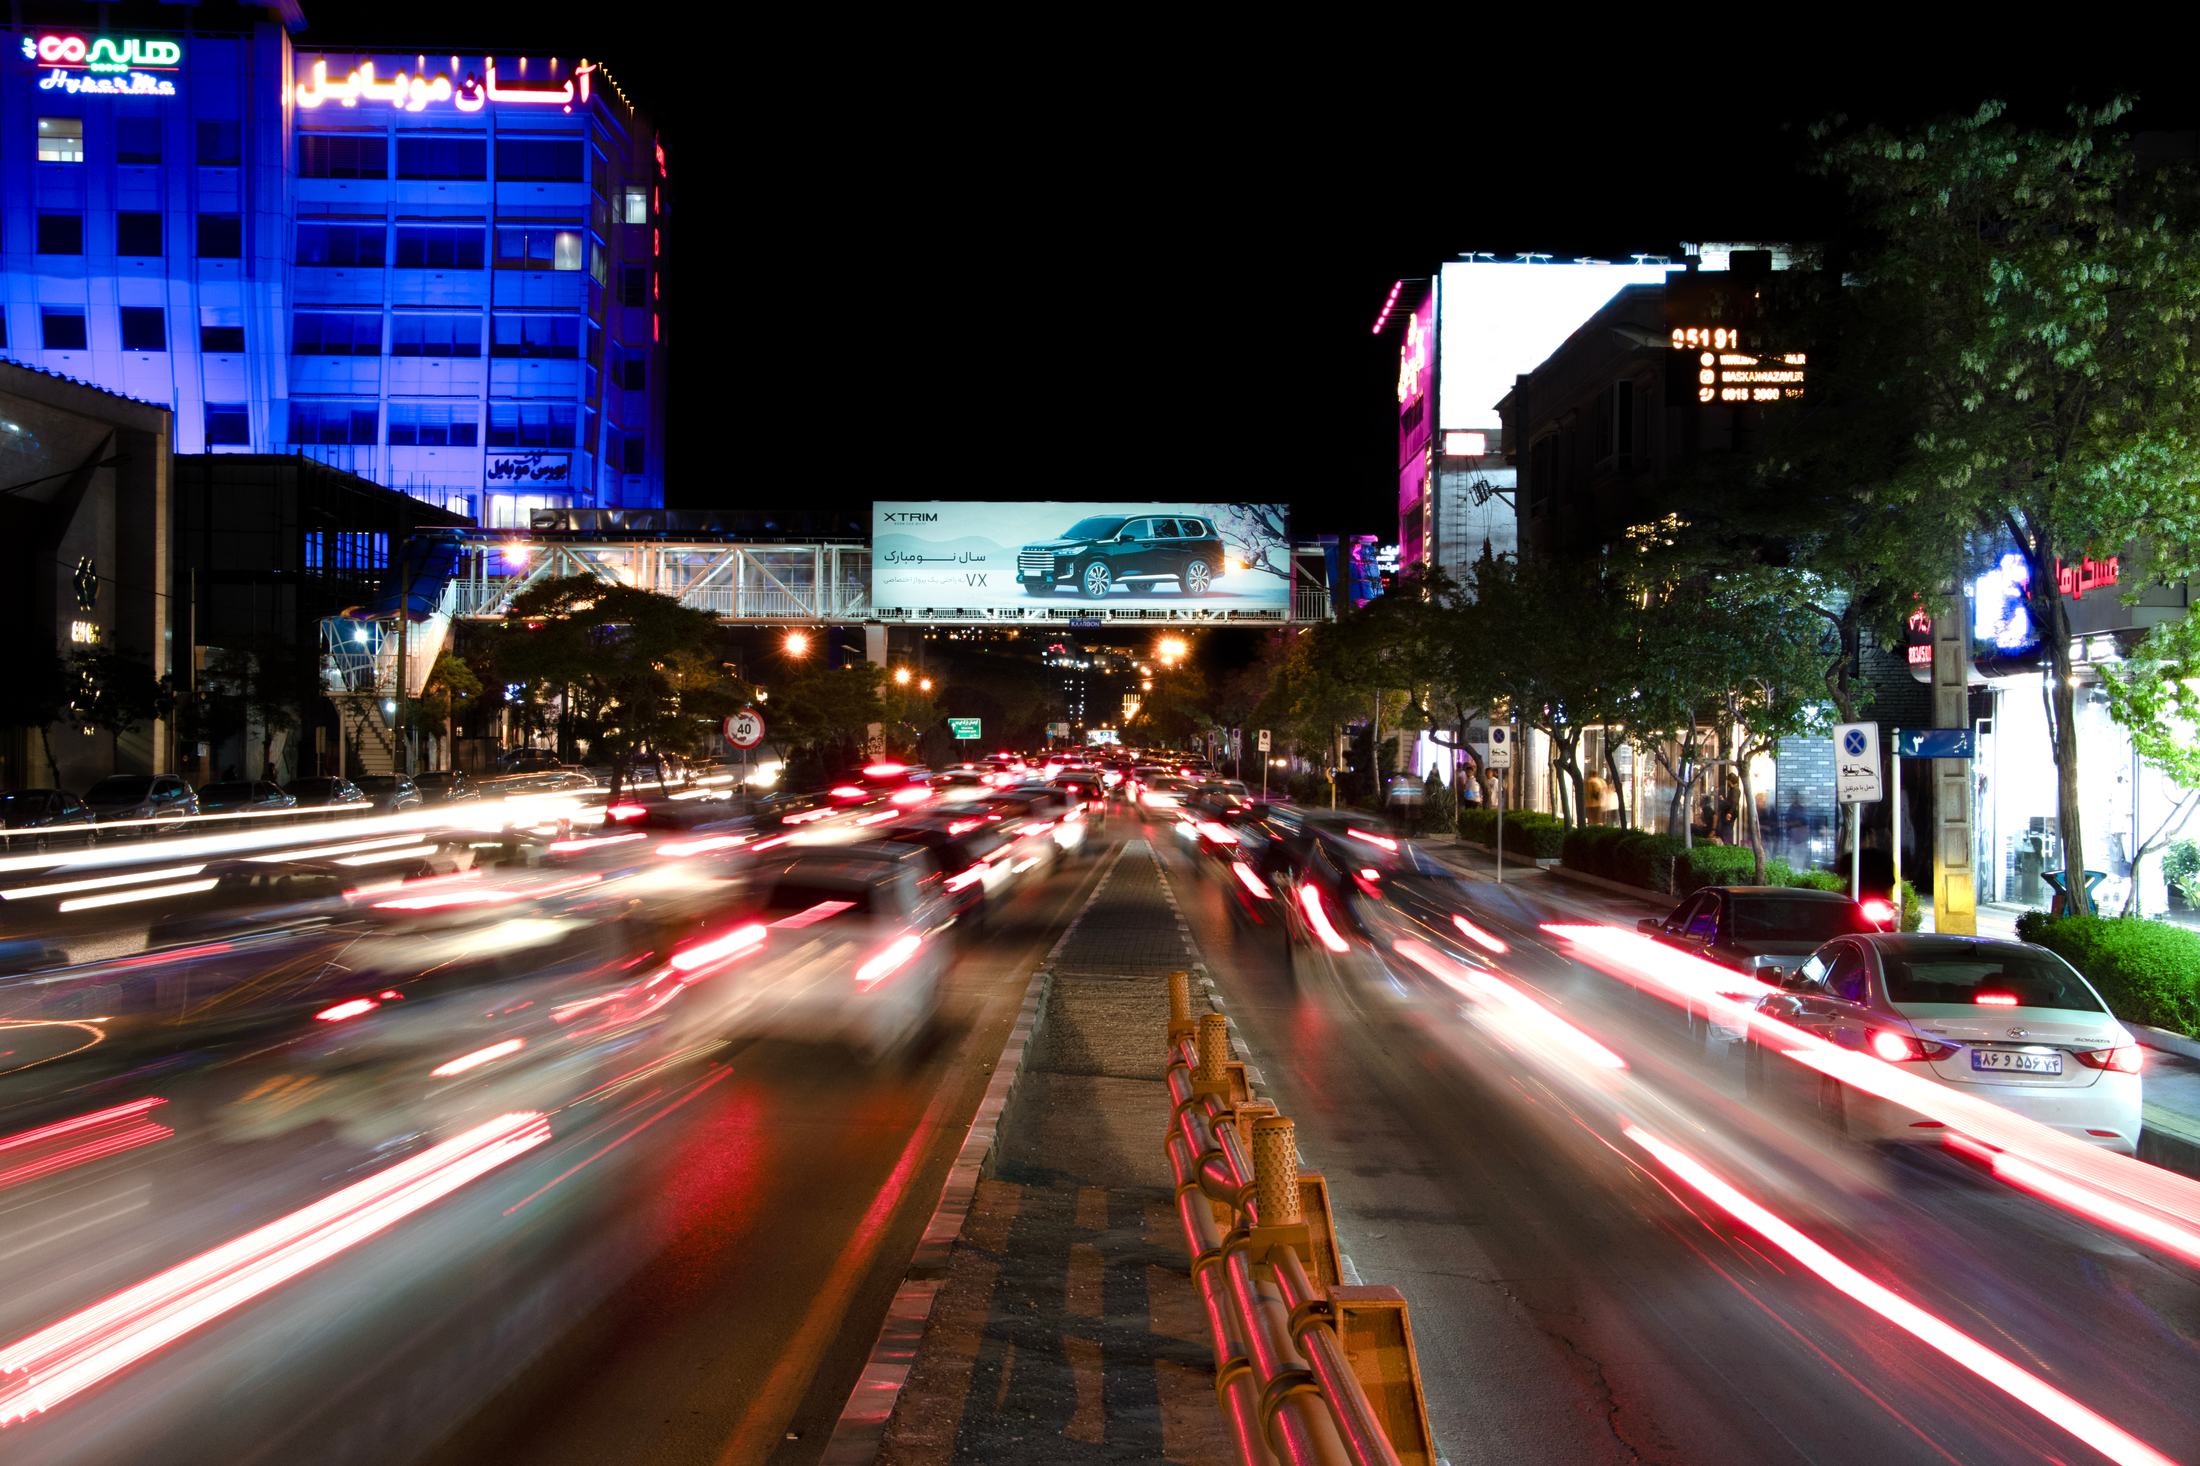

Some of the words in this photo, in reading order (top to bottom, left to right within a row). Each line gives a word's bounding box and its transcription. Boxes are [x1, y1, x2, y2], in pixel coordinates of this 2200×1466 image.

[296, 60, 451, 111] موبایل
[455, 63, 597, 114] آبان
[487, 459, 530, 480] موبایل
[884, 513, 938, 522] XTRIM
[884, 550, 916, 565] مبارک
[959, 551, 986, 564] سال
[966, 573, 988, 587] VX
[737, 723, 752, 735] 40
[1912, 735, 1925, 753] ۳
[1982, 1053, 1999, 1067] ۸۶
[2016, 1058, 2039, 1070] ۵۵۶
